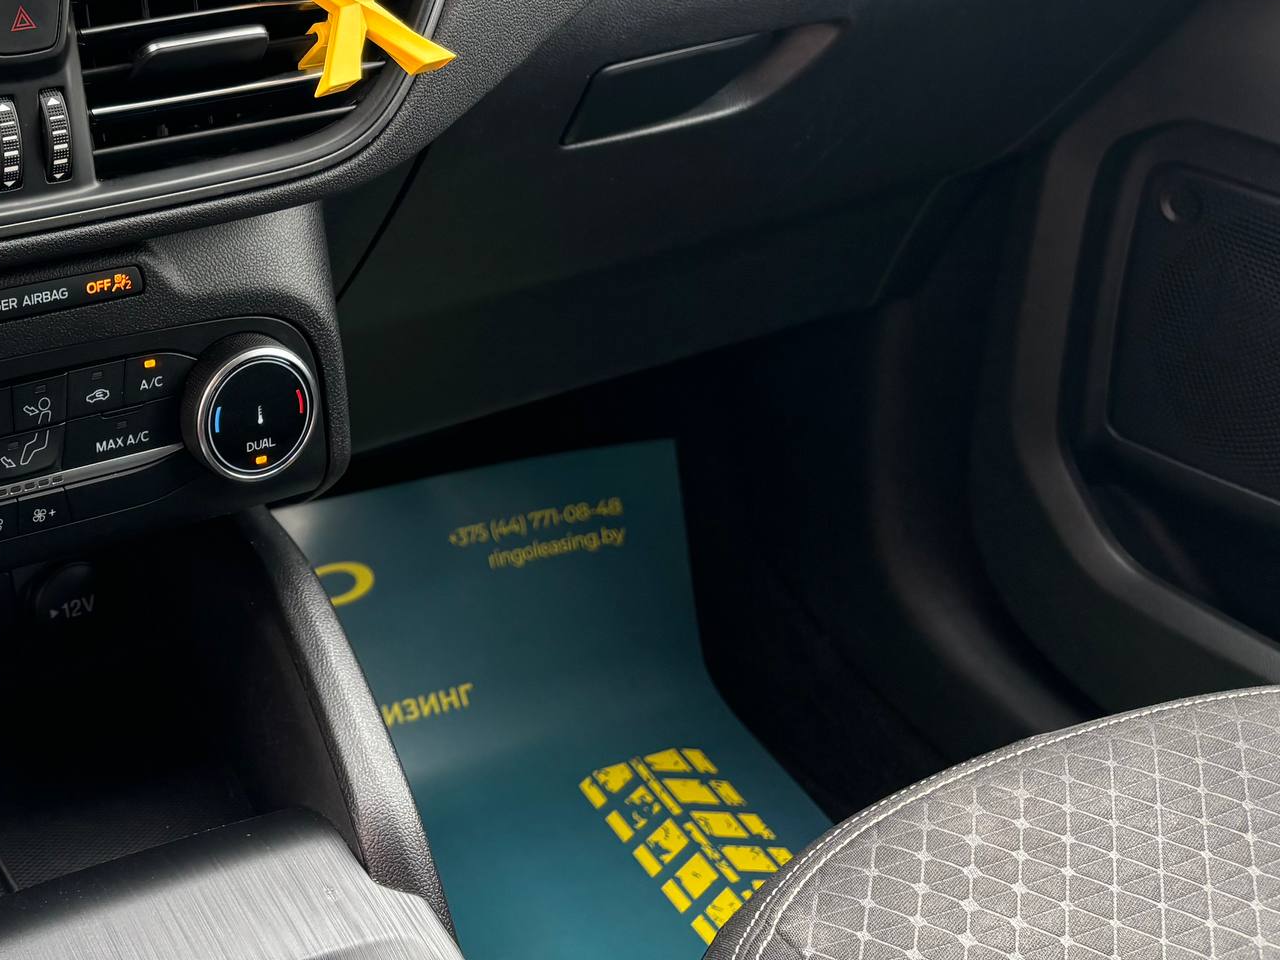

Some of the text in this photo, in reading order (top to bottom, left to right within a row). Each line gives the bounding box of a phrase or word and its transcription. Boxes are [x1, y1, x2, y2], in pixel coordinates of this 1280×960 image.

[22, 287, 69, 308] AIRBAG
[86, 278, 112, 295] OFF
[139, 376, 164, 391] A/C
[95, 430, 151, 453] MAX A/C
[246, 437, 277, 453] DUAL
[448, 523, 489, 546] +375
[489, 514, 527, 542] (44)
[488, 526, 625, 569] ringoleasing.by
[61, 594, 95, 618] 12V
